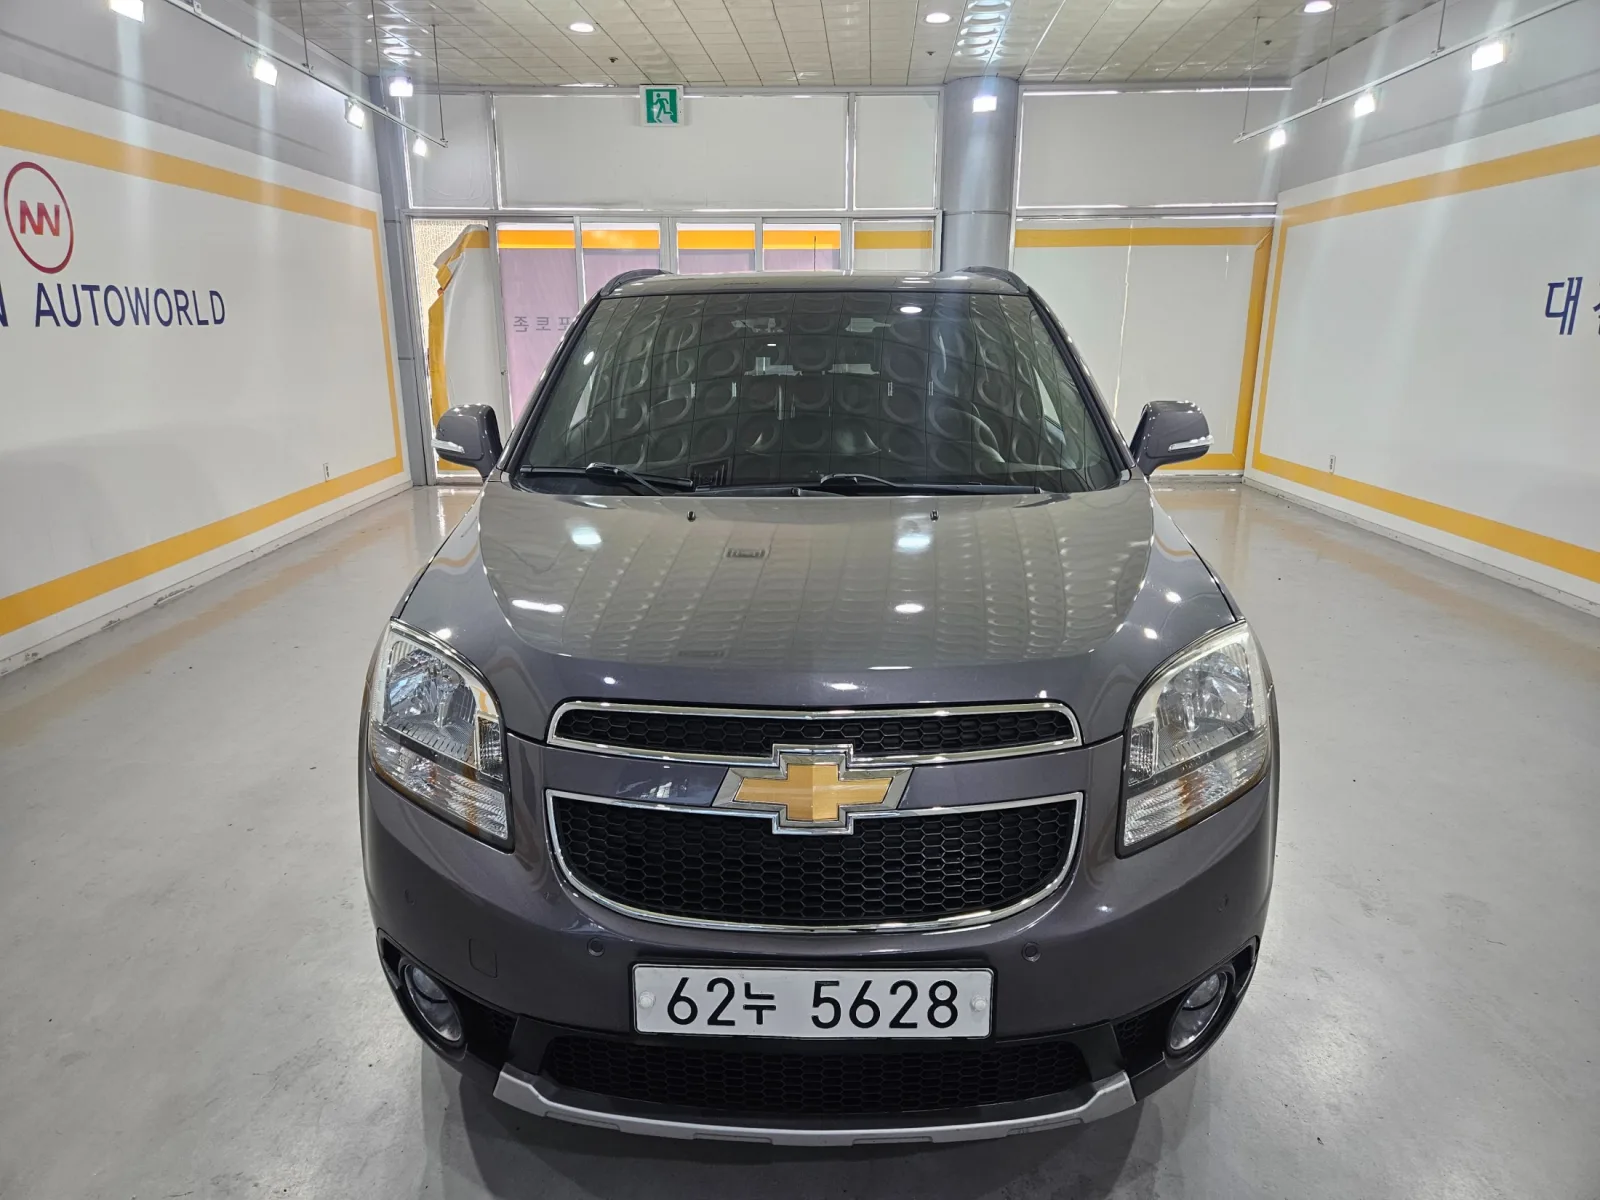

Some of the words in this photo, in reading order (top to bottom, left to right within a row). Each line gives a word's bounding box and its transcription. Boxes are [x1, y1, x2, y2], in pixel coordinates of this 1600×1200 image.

[35, 282, 225, 327] AUTOWORLD
[1545, 277, 1600, 335] 대
[667, 977, 777, 1026] 62누
[811, 980, 959, 1030] 5628
